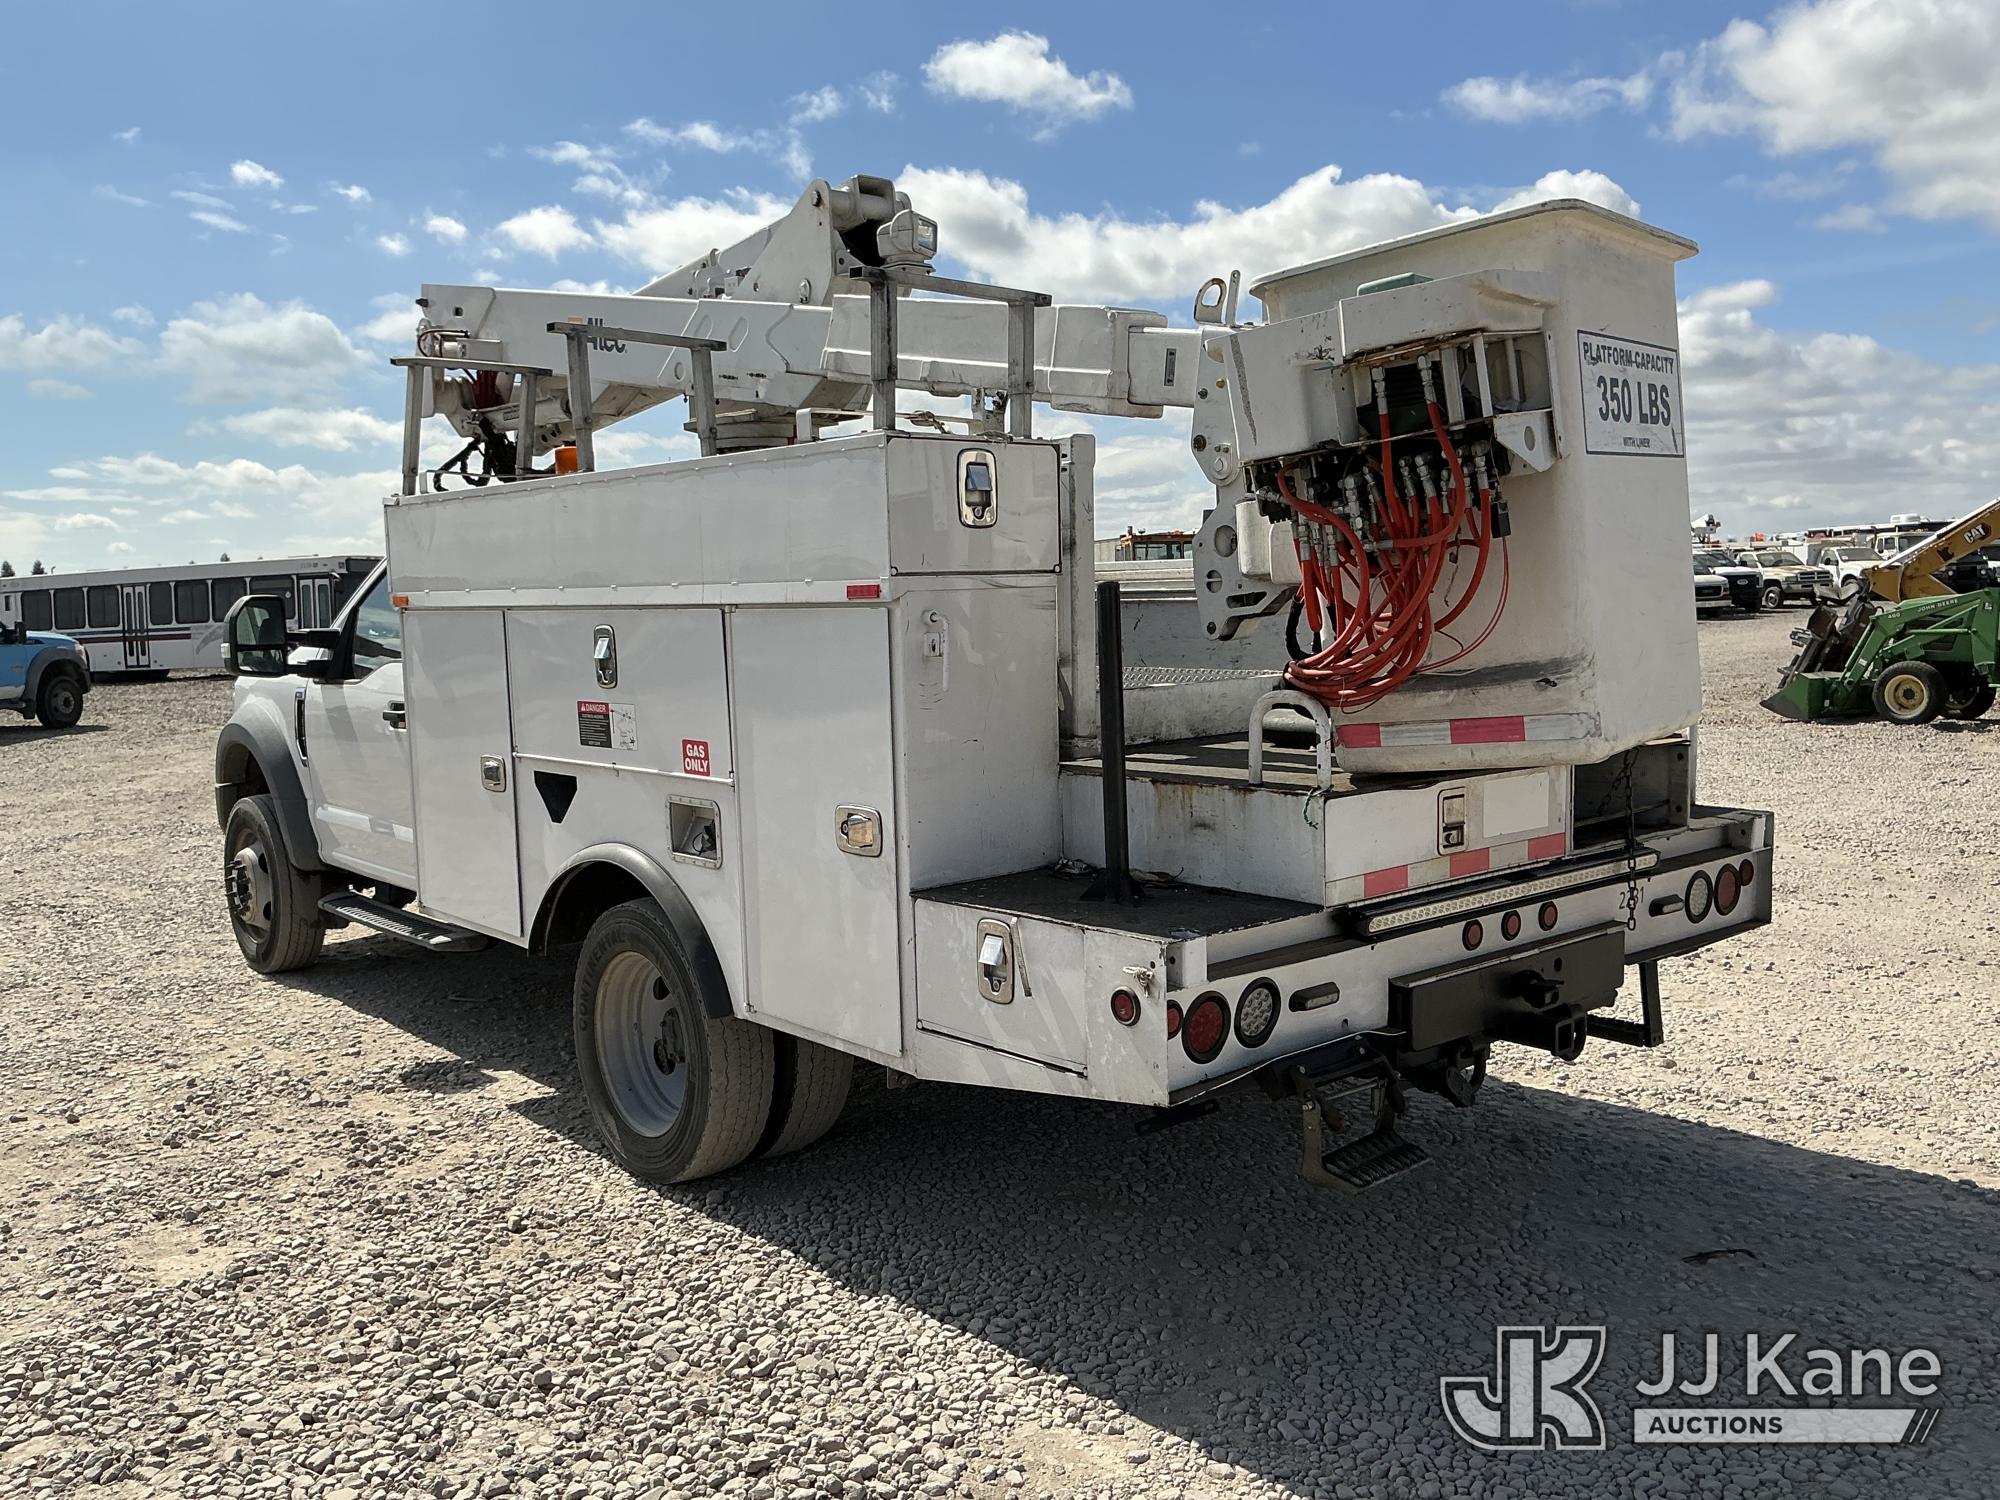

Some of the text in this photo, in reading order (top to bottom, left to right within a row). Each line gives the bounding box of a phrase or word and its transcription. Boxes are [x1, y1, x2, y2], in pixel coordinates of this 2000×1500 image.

[1583, 342, 1675, 374] PLATFORM CAPACITY
[1596, 375, 1671, 427] 350 LBS
[1964, 524, 1986, 544] CAT
[1917, 598, 1958, 613] JOHN DEERE
[585, 703, 606, 713] DANGER
[686, 744, 705, 759] GAS
[684, 757, 708, 773] ONLY
